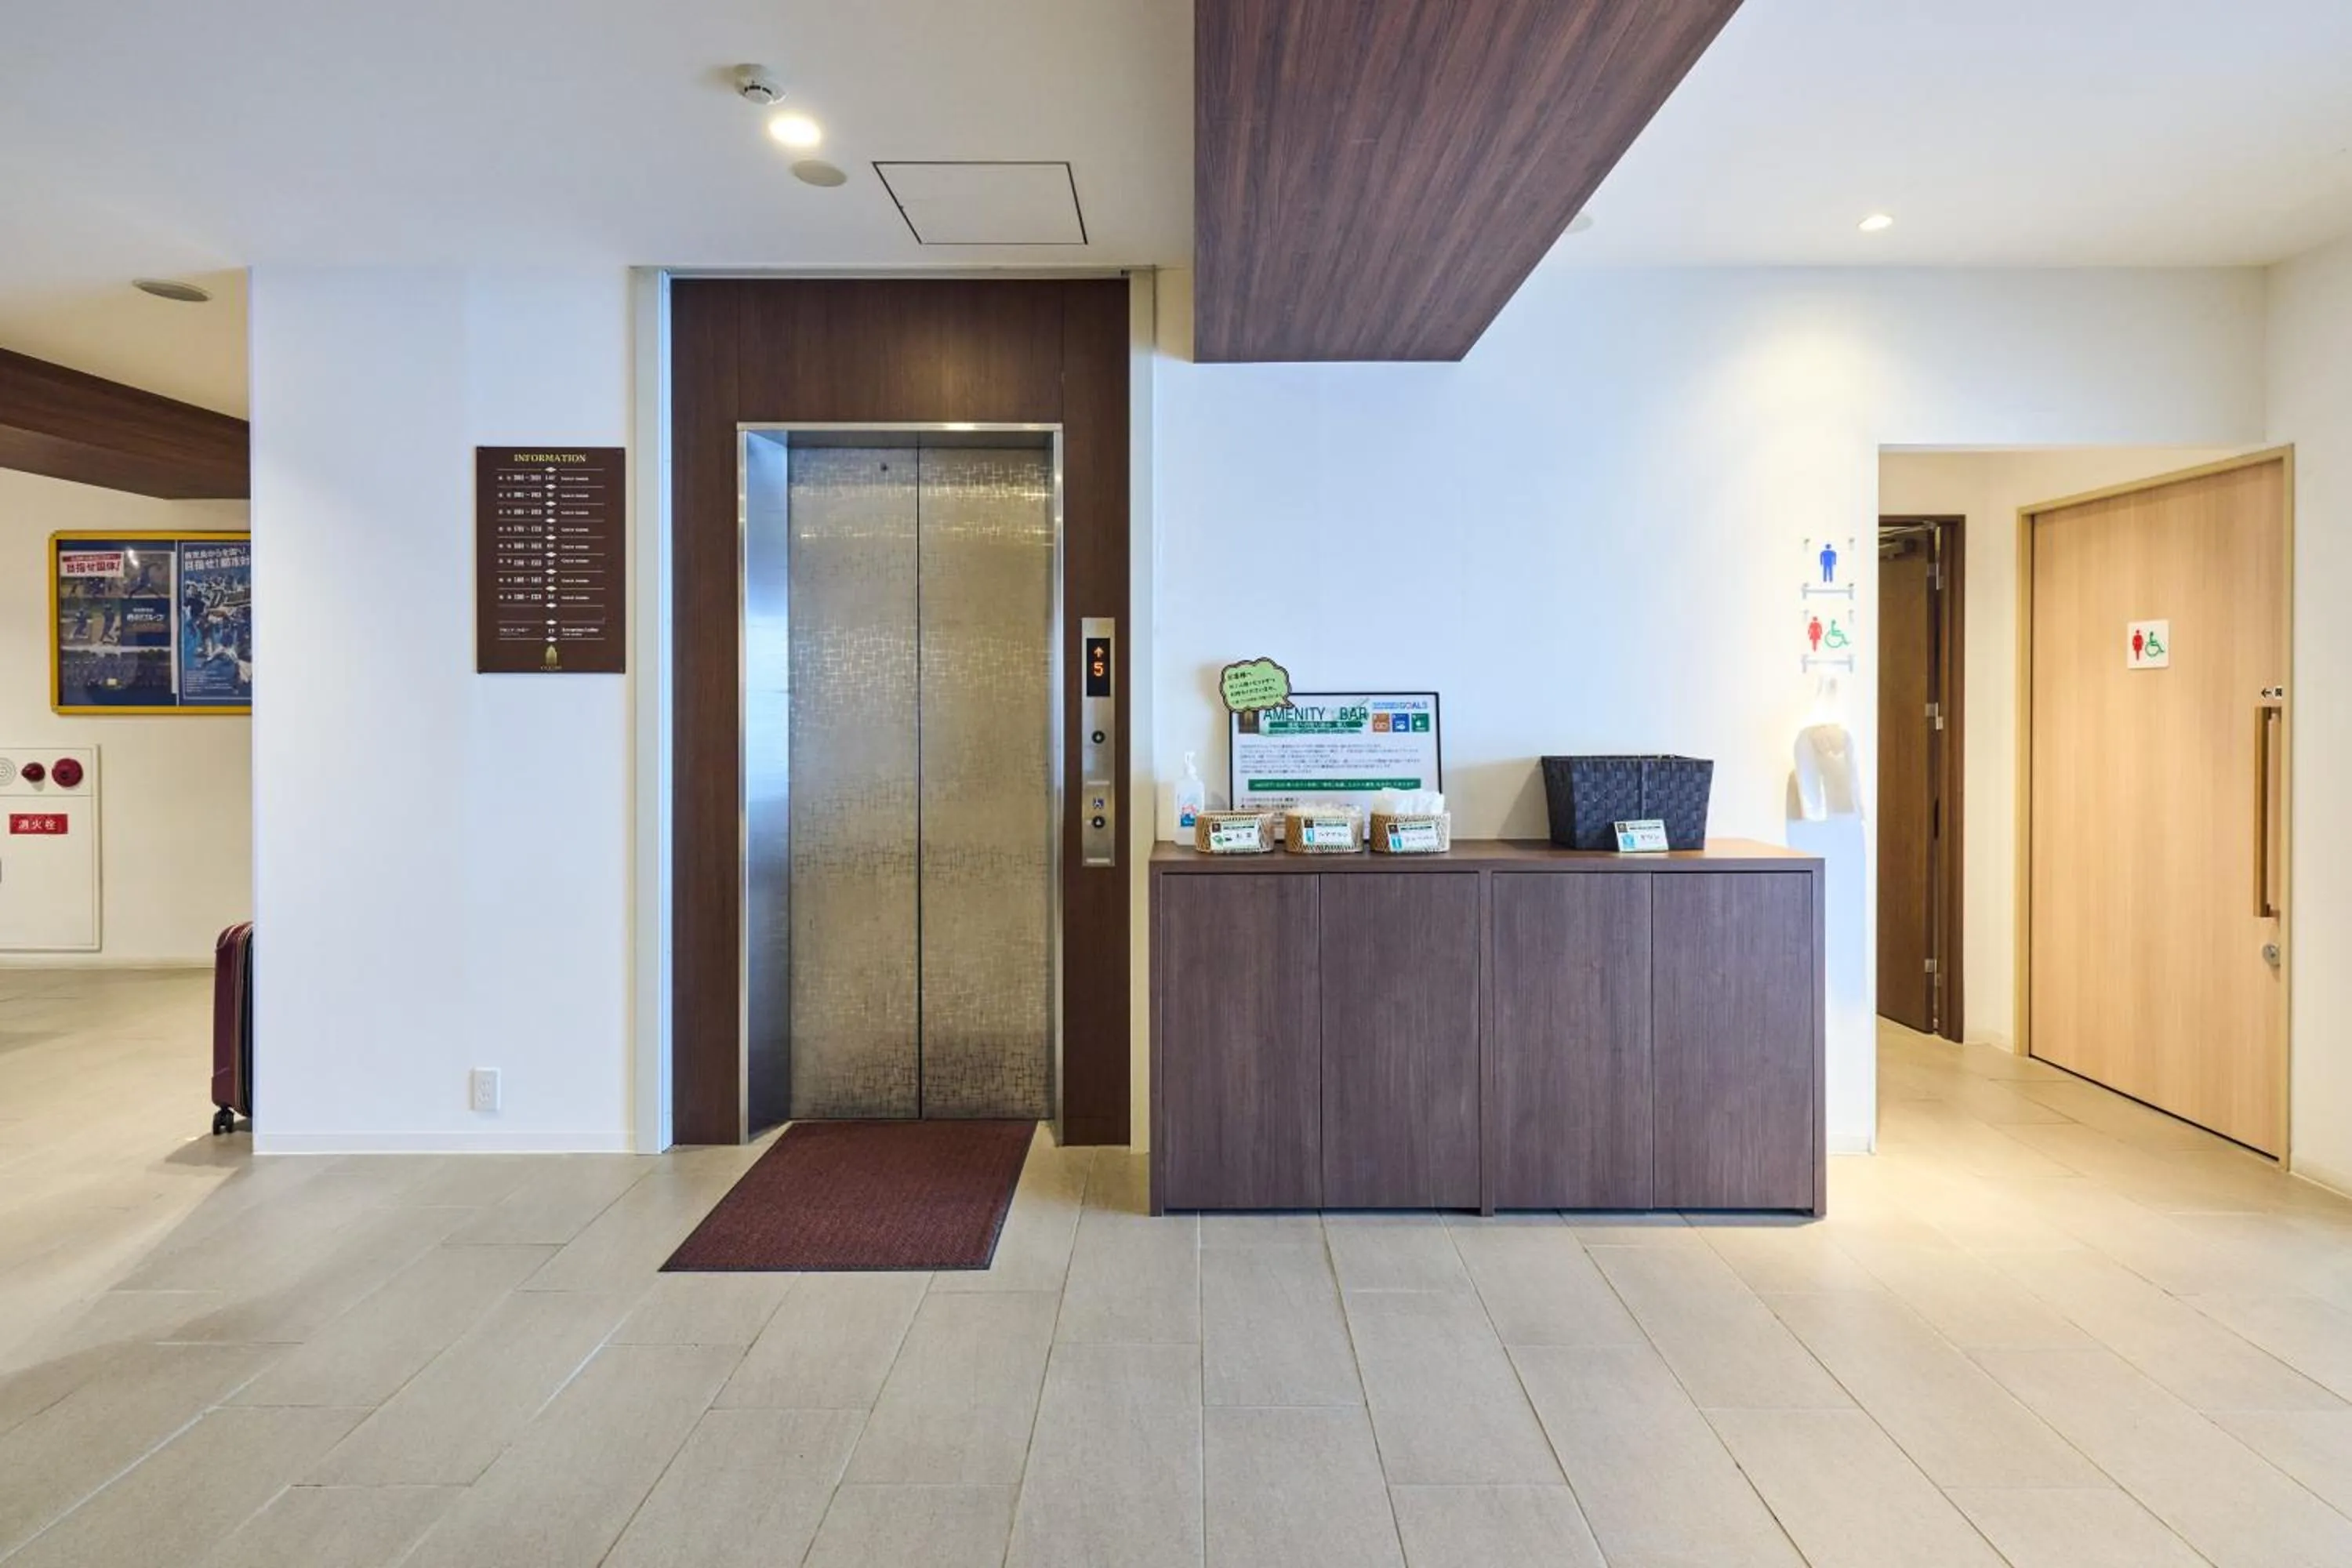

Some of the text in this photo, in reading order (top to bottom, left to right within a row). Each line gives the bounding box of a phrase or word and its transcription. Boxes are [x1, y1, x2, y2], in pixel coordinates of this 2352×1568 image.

[514, 454, 586, 463] INFORMATION
[1093, 661, 1104, 677] 5
[1263, 706, 1369, 720] AMENITY BAR
